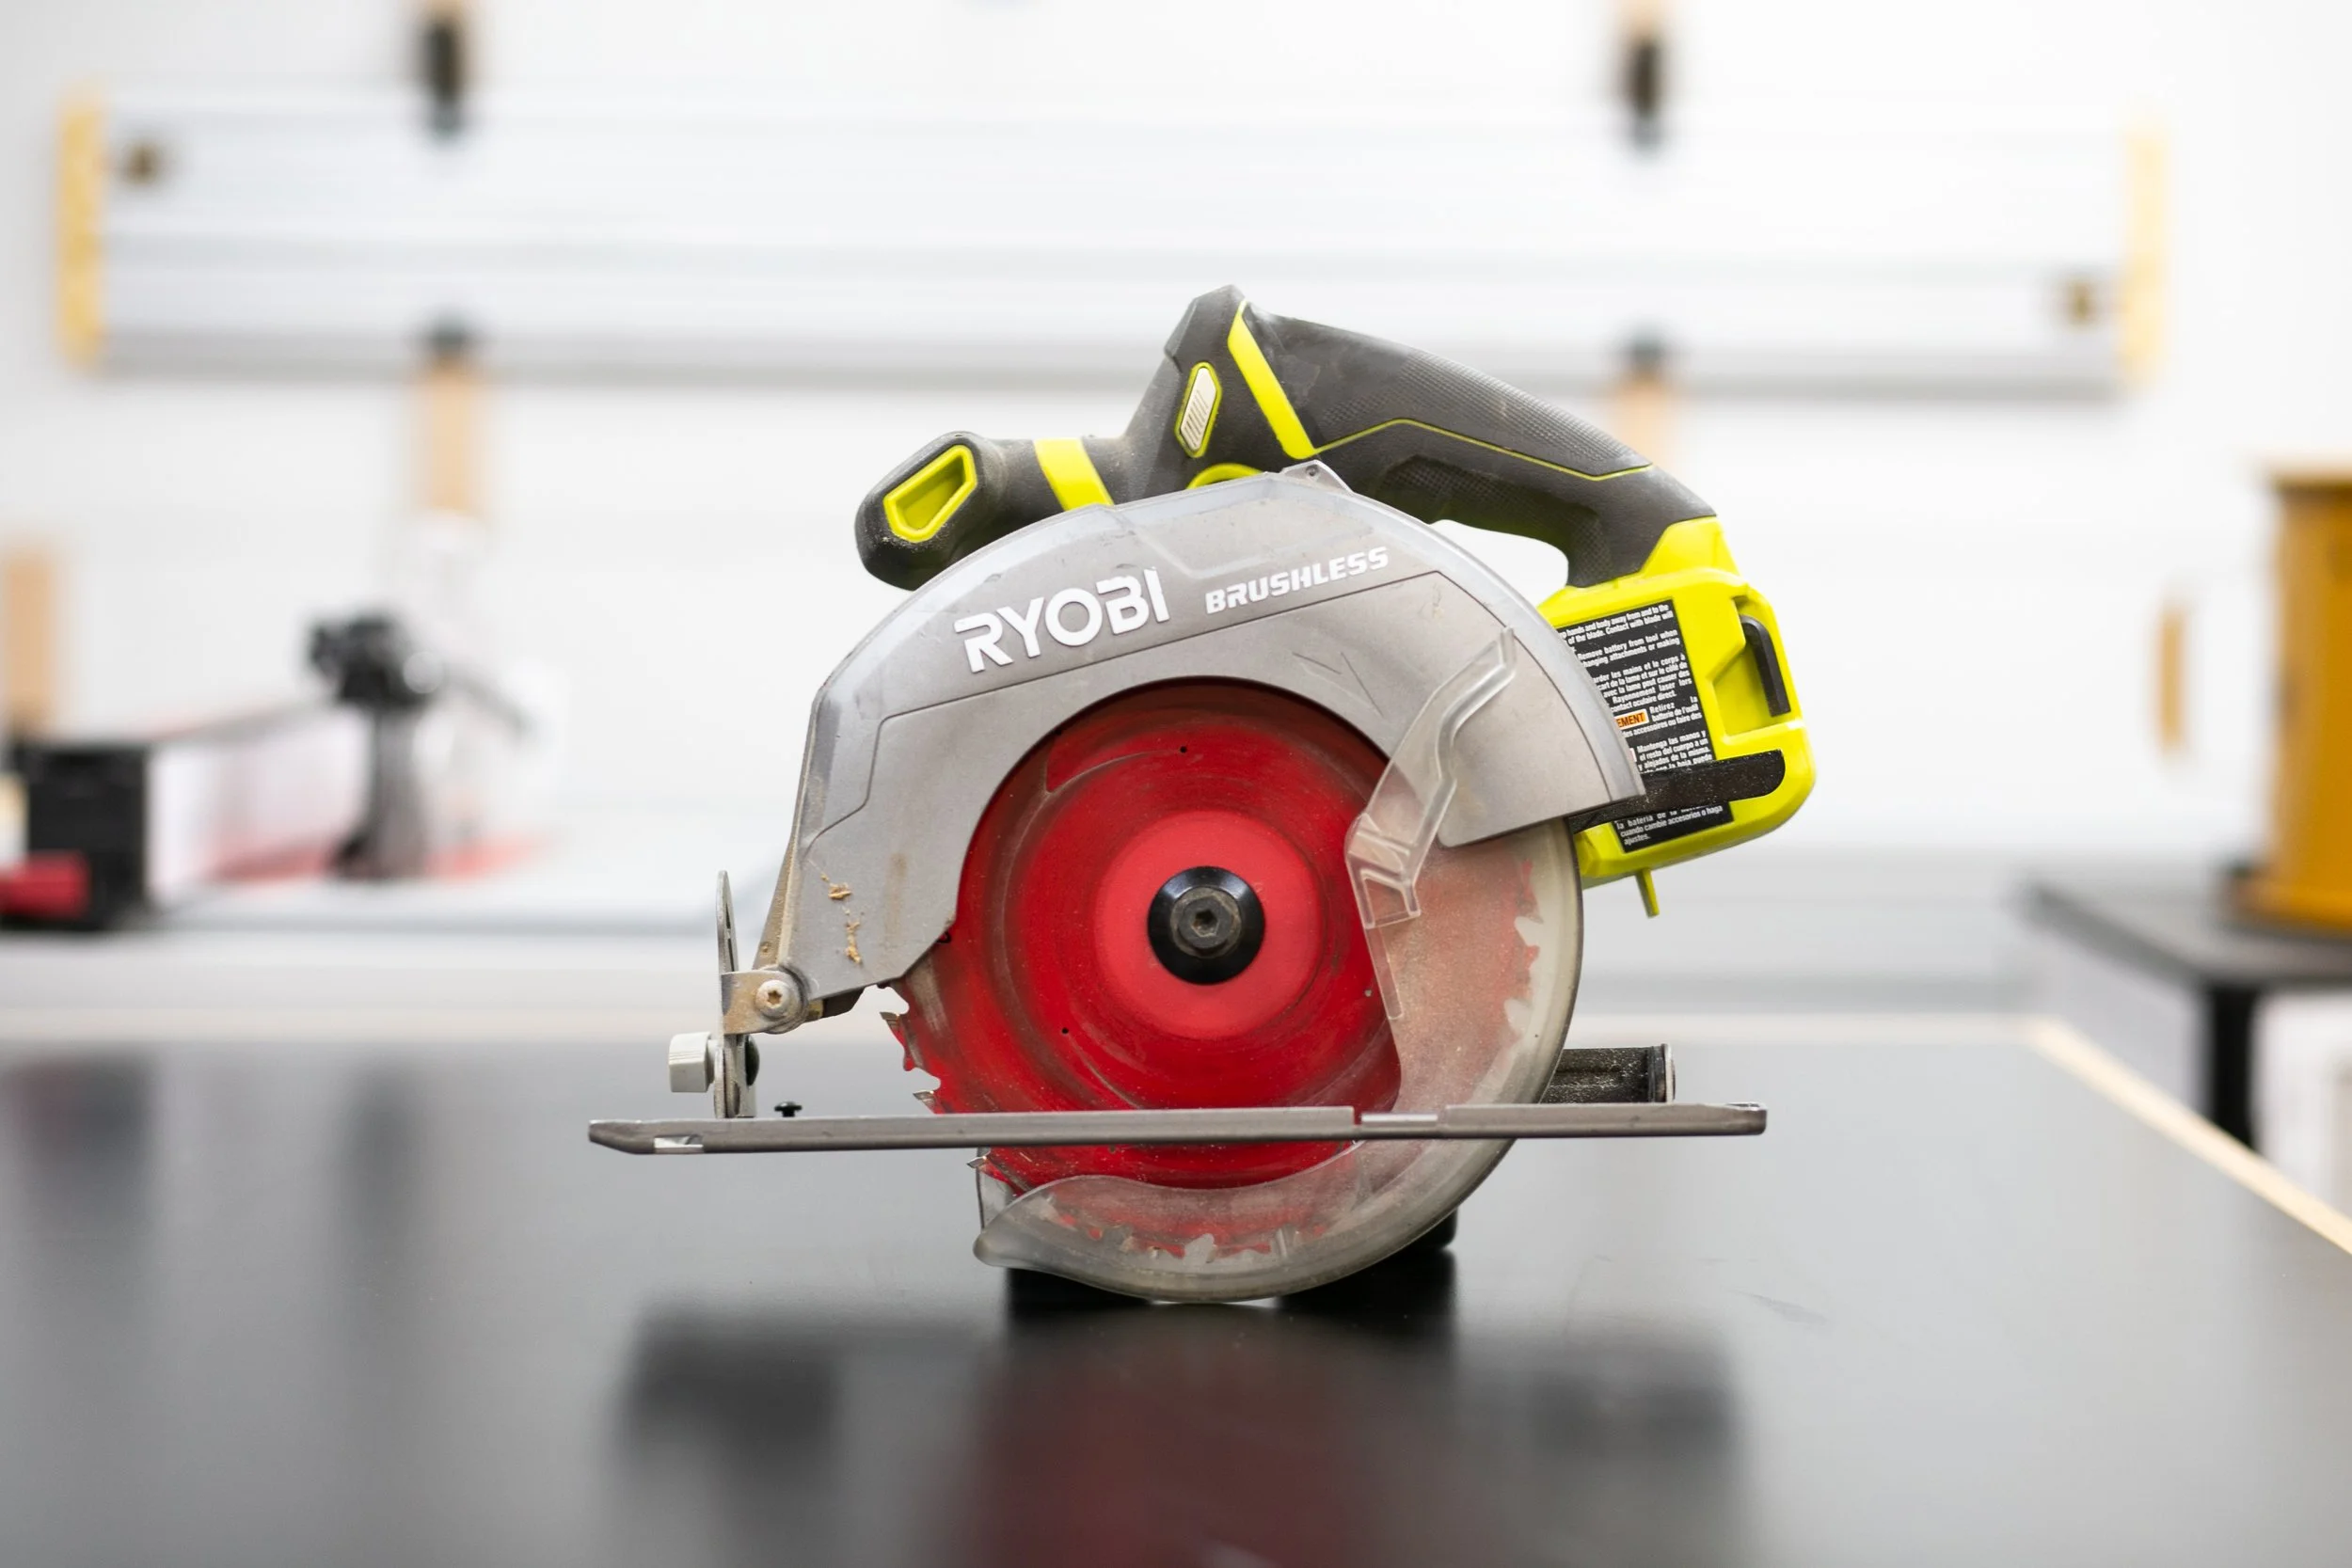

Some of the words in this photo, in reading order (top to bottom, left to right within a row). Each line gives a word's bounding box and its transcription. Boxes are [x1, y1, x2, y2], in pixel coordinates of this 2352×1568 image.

[1206, 546, 1390, 614] BRUSHLESS
[955, 567, 1169, 673] RYOBI
[1565, 626, 1585, 637] hands
[1584, 622, 1597, 632] and
[1596, 619, 1611, 628] body
[1611, 615, 1627, 625] away
[1626, 611, 1642, 621] from
[1641, 608, 1653, 617] and
[1658, 604, 1669, 612] the
[1567, 636, 1575, 644] of
[1586, 629, 1606, 640] blade.
[1605, 622, 1629, 635] Contact
[1629, 619, 1644, 628] with
[1644, 614, 1661, 625] blade
[1661, 610, 1674, 620] will
[1577, 649, 1603, 662] Remove
[1603, 642, 1628, 654] battery
[1628, 638, 1645, 647] from
[1645, 633, 1659, 643] tool
[1660, 629, 1678, 640] when
[1582, 657, 1609, 670] hanging
[1609, 646, 1647, 661] attachments
[1656, 638, 1680, 649] making
[1593, 674, 1610, 685] arder
[1611, 671, 1622, 679] les
[1622, 665, 1643, 675] mains
[1644, 662, 1652, 671] et
[1661, 656, 1679, 666] corps
[1625, 674, 1641, 684] lame
[1647, 670, 1659, 678] sur
[1678, 661, 1688, 670] de
[1603, 689, 1618, 698] avec
[1625, 683, 1642, 691] lame
[1642, 678, 1657, 689] peut
[1657, 673, 1677, 684] causer
[1678, 670, 1691, 678] des
[1612, 687, 1656, 704] Rayonnement
[1659, 682, 1676, 691] laser
[1678, 678, 1692, 687] lors
[1632, 696, 1658, 707] oculaire
[1657, 689, 1677, 701] direct.
[1649, 703, 1675, 714] Retirez
[1615, 711, 1645, 728] EMENT
[1633, 721, 1668, 736] accessoires
[1676, 715, 1691, 724] faire
[1690, 712, 1703, 721] des
[1651, 710, 1675, 722] batterie
[1636, 740, 1668, 753] Mantenga
[1679, 732, 1701, 742] manos
[1646, 750, 1662, 759] resto
[1661, 746, 1673, 755] del
[1673, 742, 1695, 753] cuerpo
[1644, 756, 1671, 768] alejados
[1687, 746, 1710, 757] misma.
[1692, 753, 1712, 765] puede
[1620, 826, 1644, 837] cuando
[1644, 820, 1667, 831] cambie
[1667, 811, 1701, 825] accesorios
[1706, 805, 1724, 815] haga
[1624, 833, 1650, 846] ajustes.
